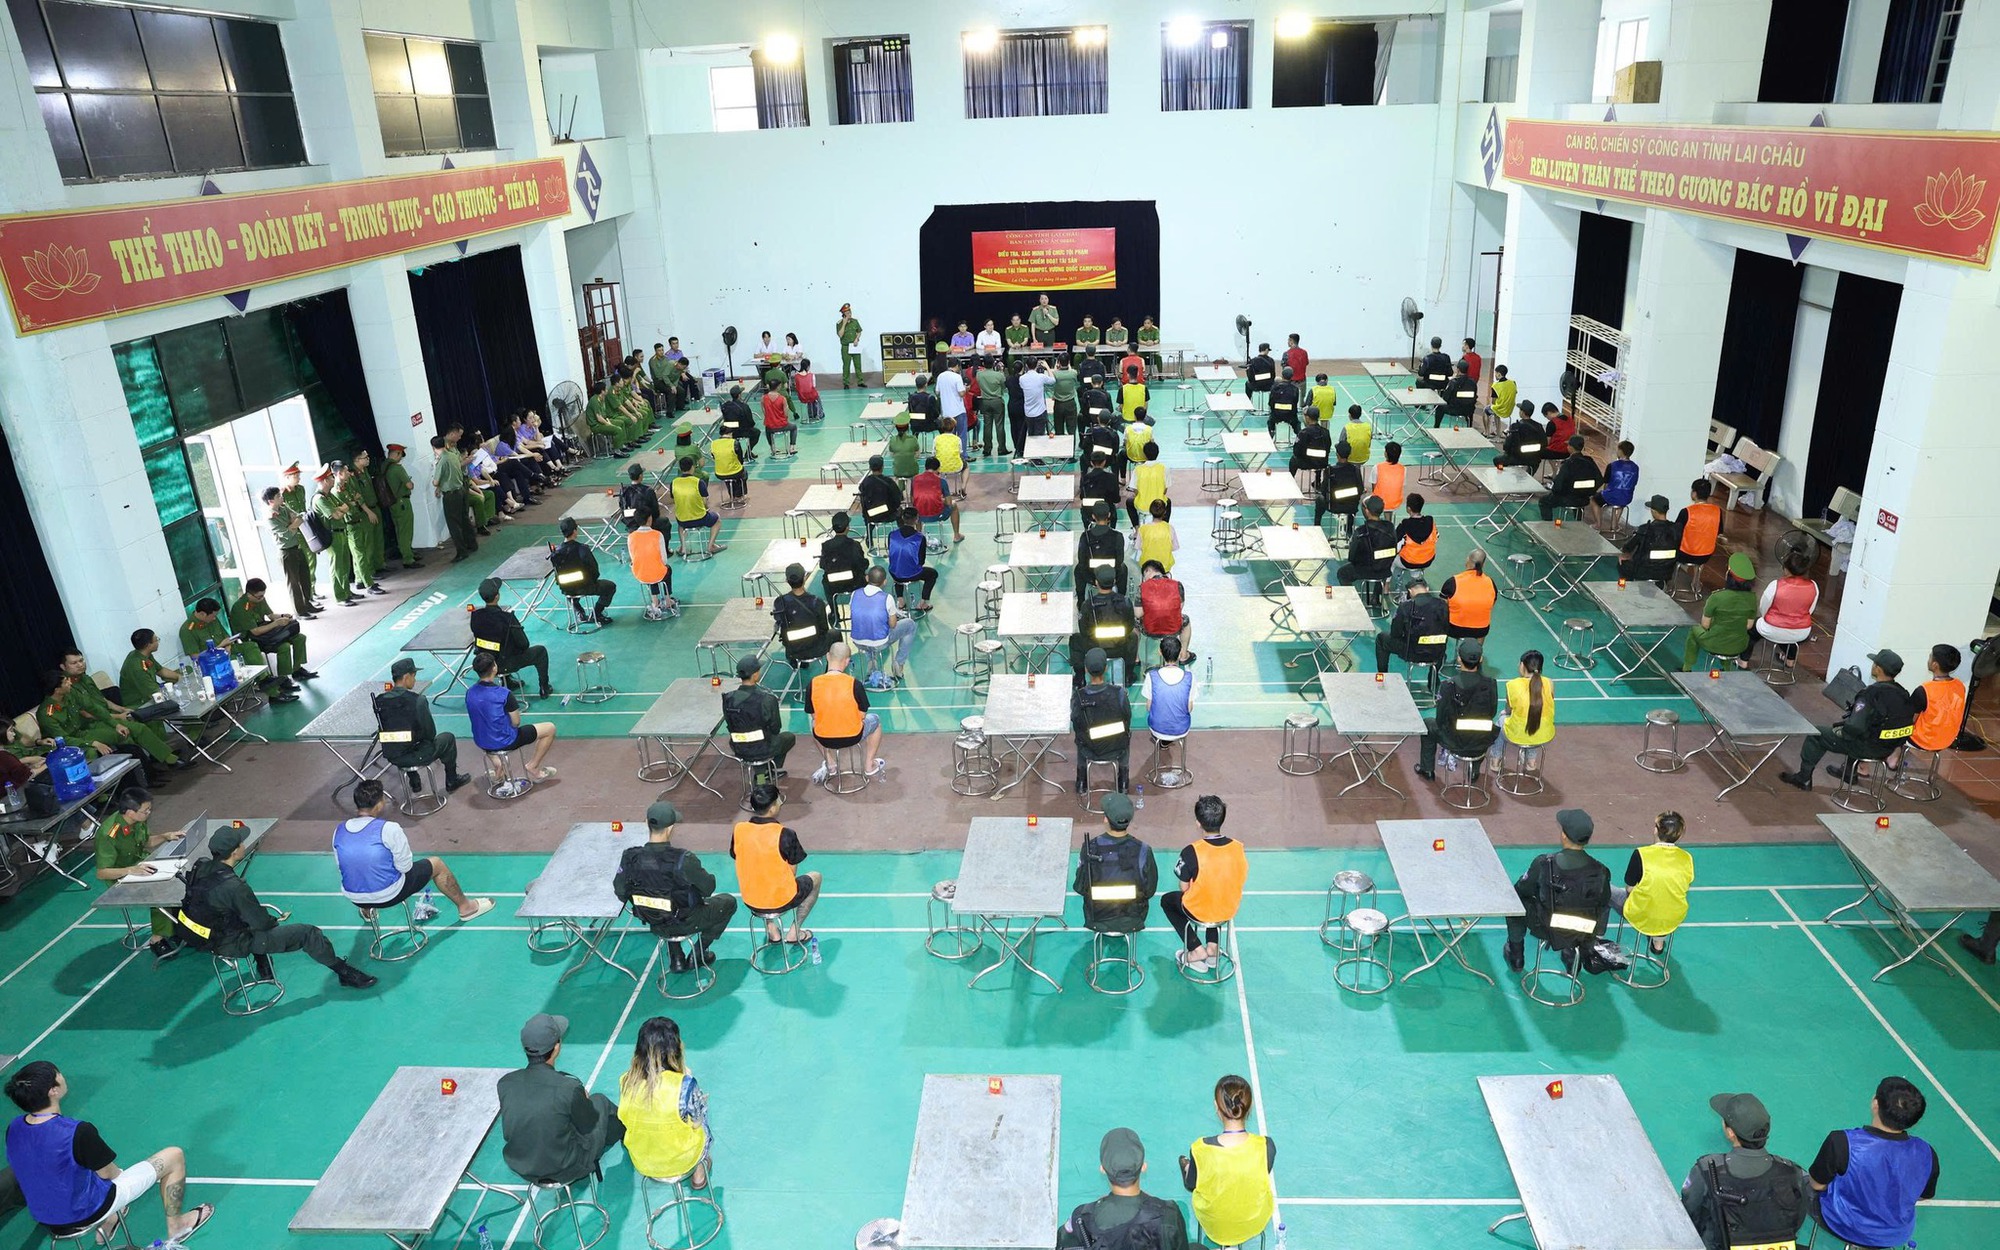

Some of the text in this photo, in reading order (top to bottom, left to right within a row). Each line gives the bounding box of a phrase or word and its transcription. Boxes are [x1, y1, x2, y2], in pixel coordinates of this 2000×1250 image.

[1566, 131, 1583, 149] CÁN
[1584, 132, 1598, 154] BỘ,
[1601, 131, 1629, 153] CHIẾN
[1647, 135, 1678, 157] CÔNG
[1681, 140, 1698, 159] AN
[1702, 135, 1731, 162] TỈNH
[1734, 144, 1757, 164] LAI
[1760, 141, 1806, 168] CHÂU
[109, 217, 165, 284] THỂ
[162, 226, 224, 275] THAO
[239, 210, 294, 262] ĐOÀN
[292, 201, 327, 251] KẾT
[338, 202, 388, 242] TRUNG
[387, 196, 423, 237] THỰC
[432, 193, 456, 225] CAO
[455, 184, 498, 222] THƯỢNG
[504, 172, 526, 210] TIẾN
[526, 172, 540, 211] BỘ
[1549, 157, 1580, 187] LUYỆN
[1582, 160, 1611, 188] THÂN
[1613, 159, 1639, 192] THỂ
[1640, 170, 1676, 198] THEO
[1678, 174, 1733, 207] GƯƠNG
[1735, 176, 1774, 213] BÁC
[1776, 176, 1809, 219] HỒ
[1814, 185, 1839, 224] VĨ
[1840, 194, 1888, 237] ĐẠI
